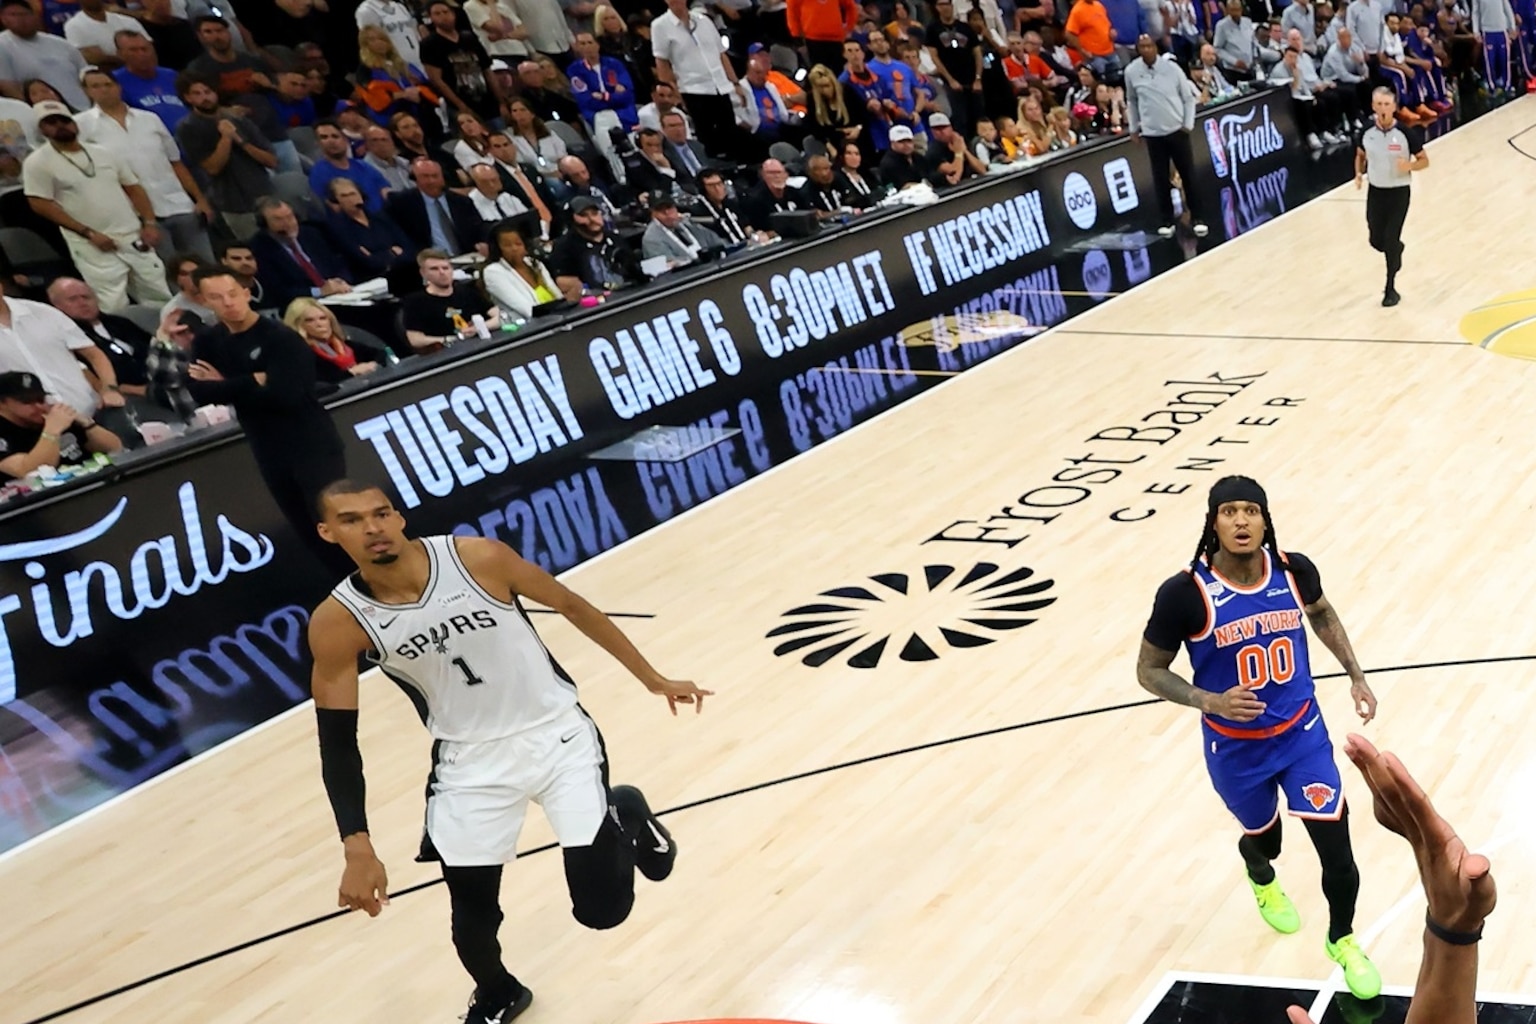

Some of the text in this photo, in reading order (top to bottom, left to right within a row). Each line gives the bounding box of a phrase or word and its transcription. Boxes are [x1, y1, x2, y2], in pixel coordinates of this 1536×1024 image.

[1220, 104, 1284, 180] Finals
[353, 353, 584, 509] TUESDAY
[588, 307, 716, 420] GAME
[697, 299, 742, 376] 6
[742, 261, 867, 358] 8:30PM
[852, 250, 896, 318] ET
[903, 226, 939, 296] IF
[928, 190, 1051, 286] NECESSARY
[1068, 190, 1092, 211] abc
[920, 370, 1269, 549] Frost Bank
[1109, 396, 1307, 523] CENTER
[395, 610, 498, 660] SPURS
[1214, 609, 1301, 648] NEW YORK
[452, 655, 483, 686] 1
[1236, 636, 1295, 690] 00
